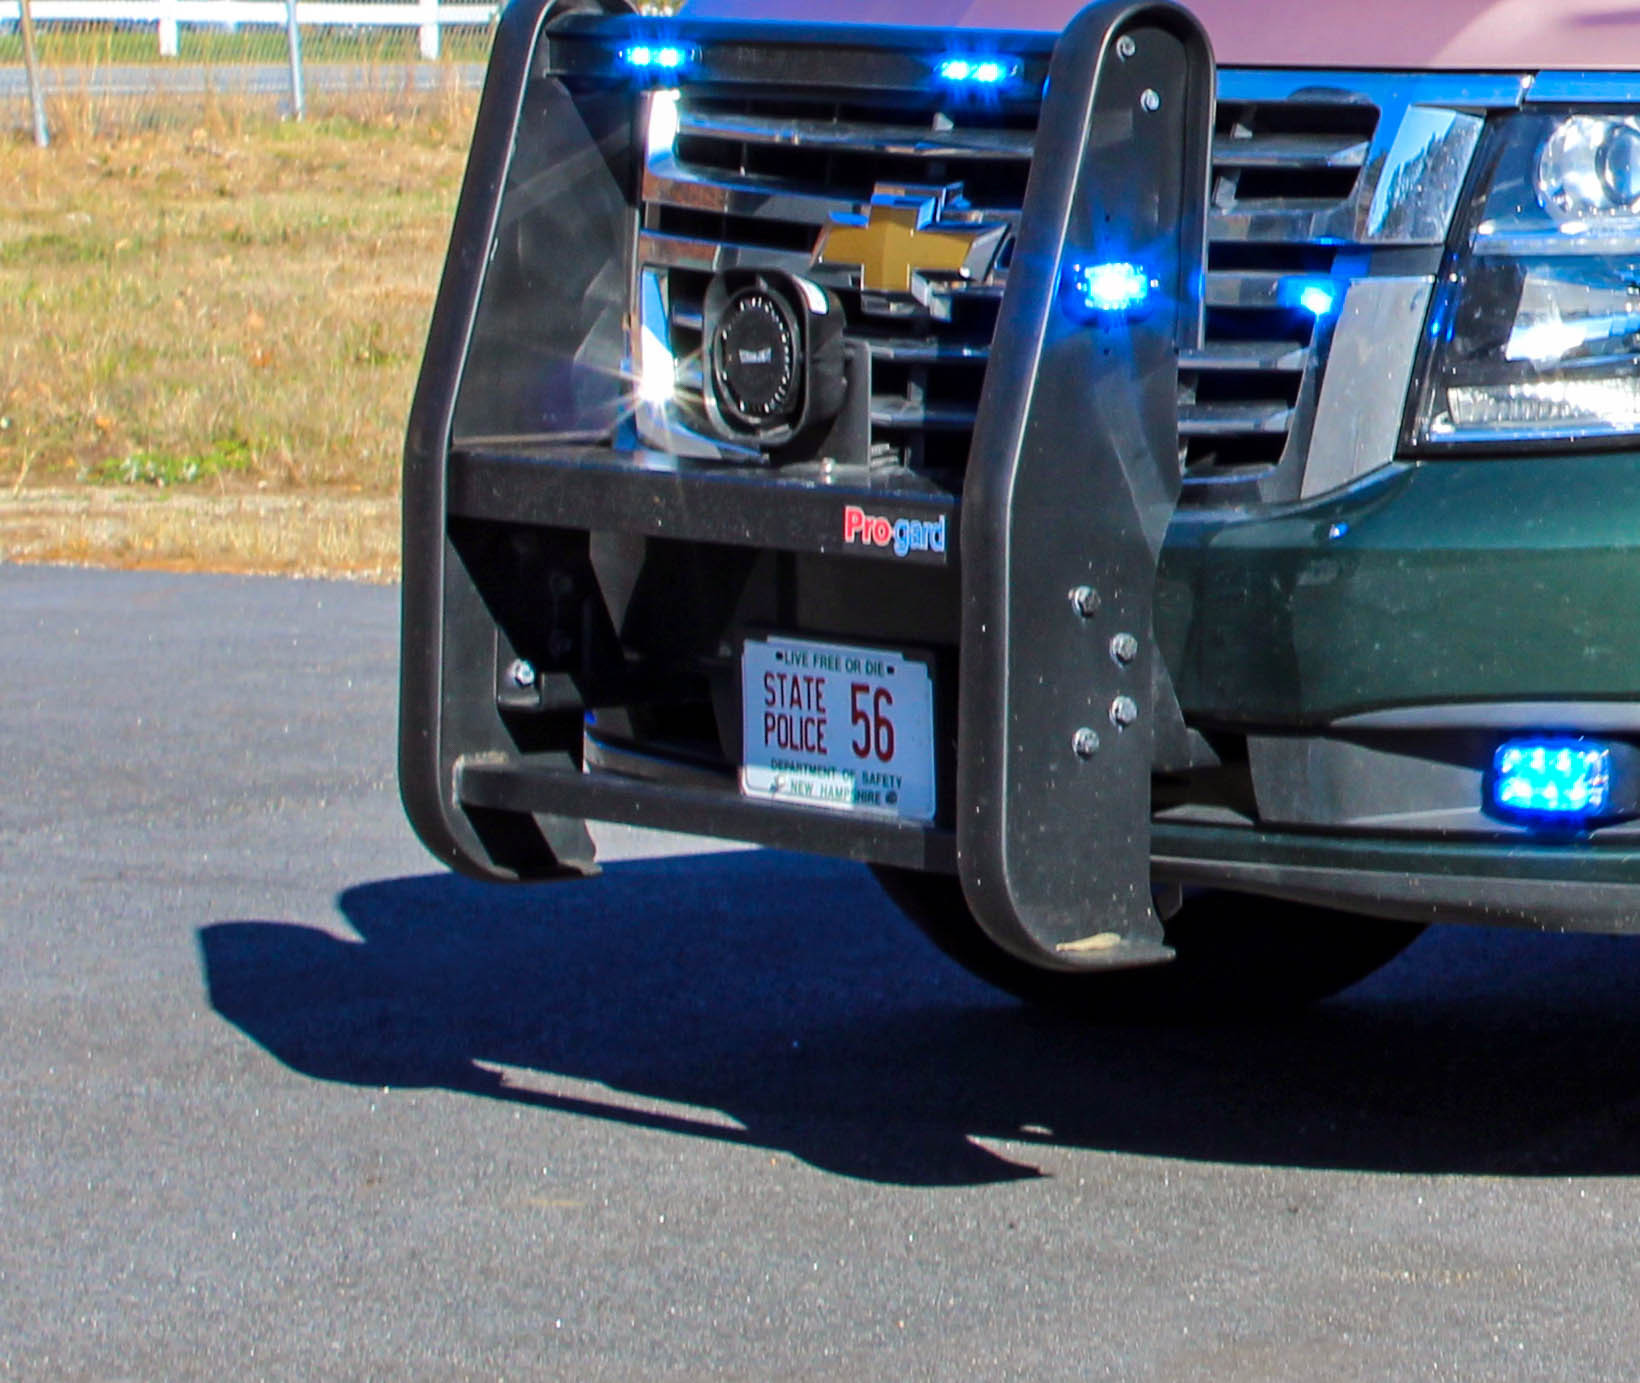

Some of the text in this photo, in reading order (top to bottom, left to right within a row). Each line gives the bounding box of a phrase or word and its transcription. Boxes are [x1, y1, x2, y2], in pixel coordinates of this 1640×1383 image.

[784, 653, 884, 676] LIVE FREE OR DIE
[764, 670, 895, 763] STATE 56
[764, 711, 828, 756] POLICE
[770, 758, 836, 780] DEPARTMENT
[861, 769, 902, 789] SAFETY
[790, 780, 882, 806] NEW HAMPHIRE
